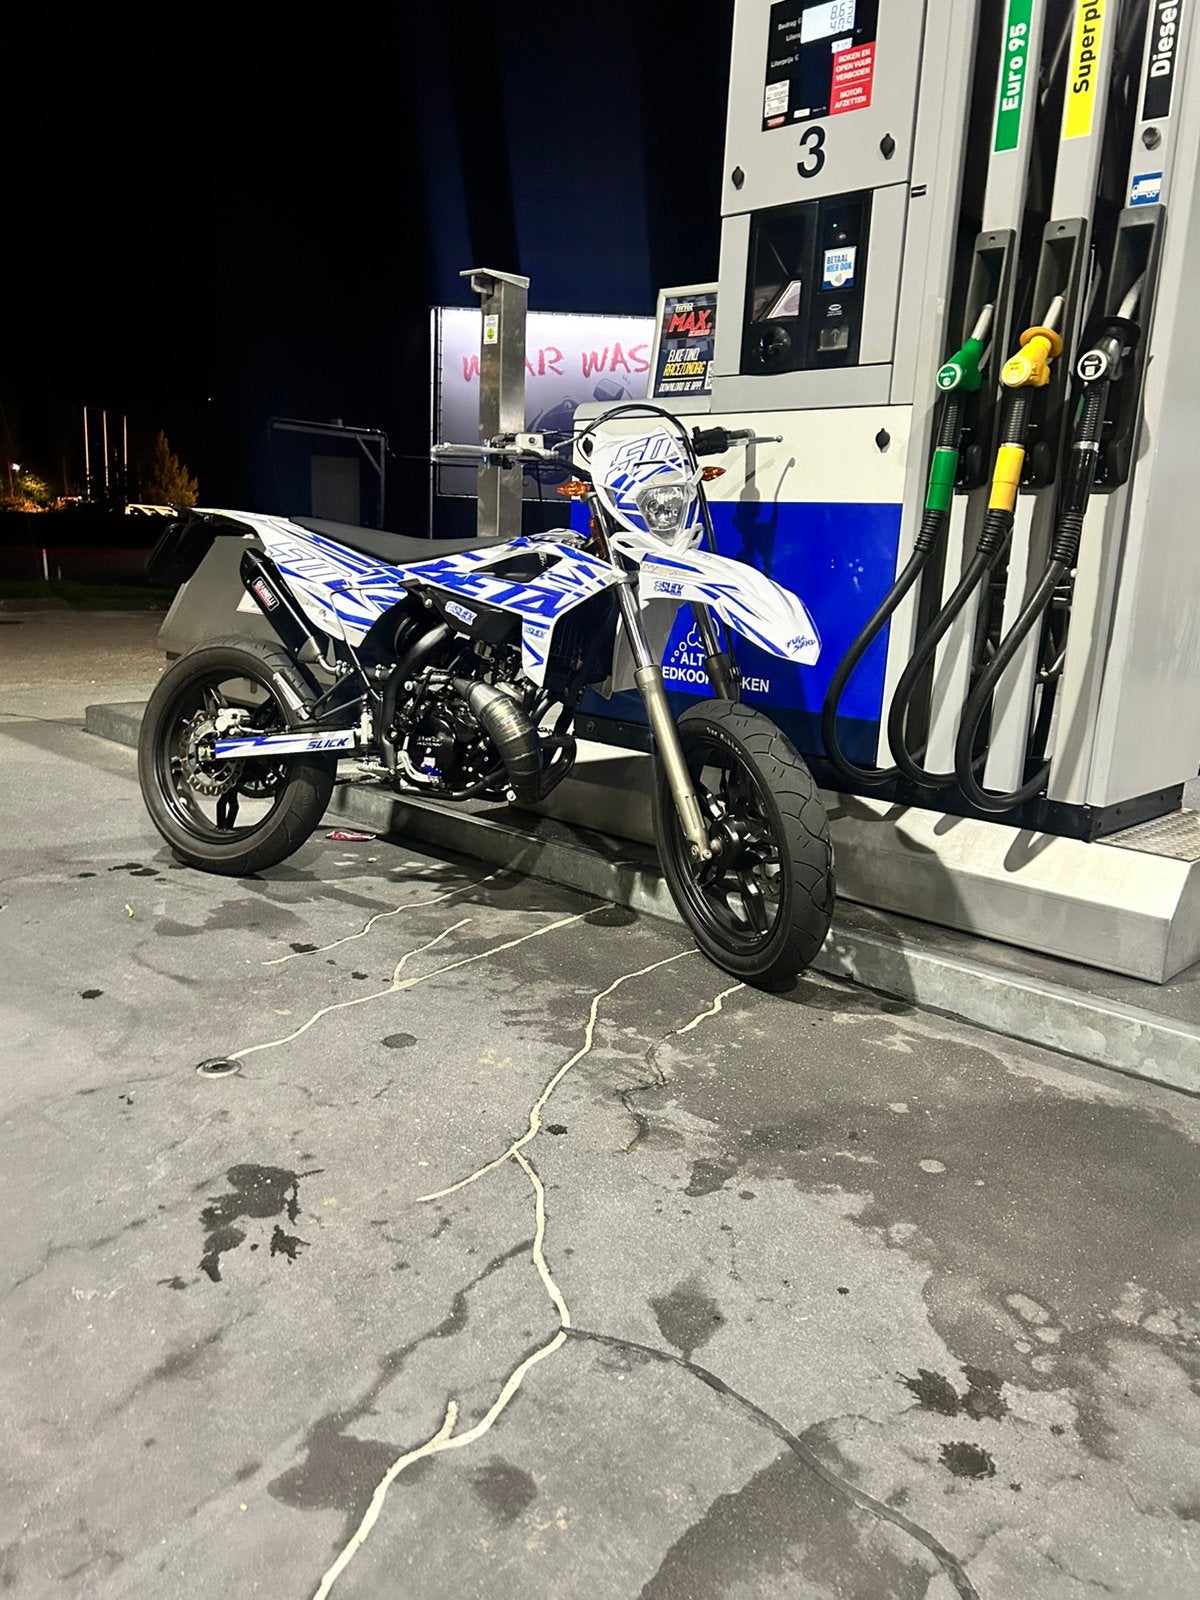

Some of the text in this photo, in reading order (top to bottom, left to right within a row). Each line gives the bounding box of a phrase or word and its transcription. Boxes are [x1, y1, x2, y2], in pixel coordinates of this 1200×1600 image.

[1150, 0, 1179, 78] Diesel
[838, 48, 870, 62] ROKEN EN
[836, 57, 871, 72] OPEN VUUR
[1001, 22, 1027, 112] Euro 95
[836, 66, 871, 82] VERBODEN
[839, 87, 862, 98] MOTOR
[834, 95, 866, 108] AFZETTEN
[796, 125, 826, 179] 3
[827, 254, 847, 264] BETAAL
[667, 348, 684, 363] ELKE
[663, 361, 706, 377] RACEZONDAG
[658, 382, 684, 392] DOWNLOAD
[680, 652, 707, 667] ALT
[740, 676, 770, 693] KEN
[305, 737, 348, 749] SLICK
